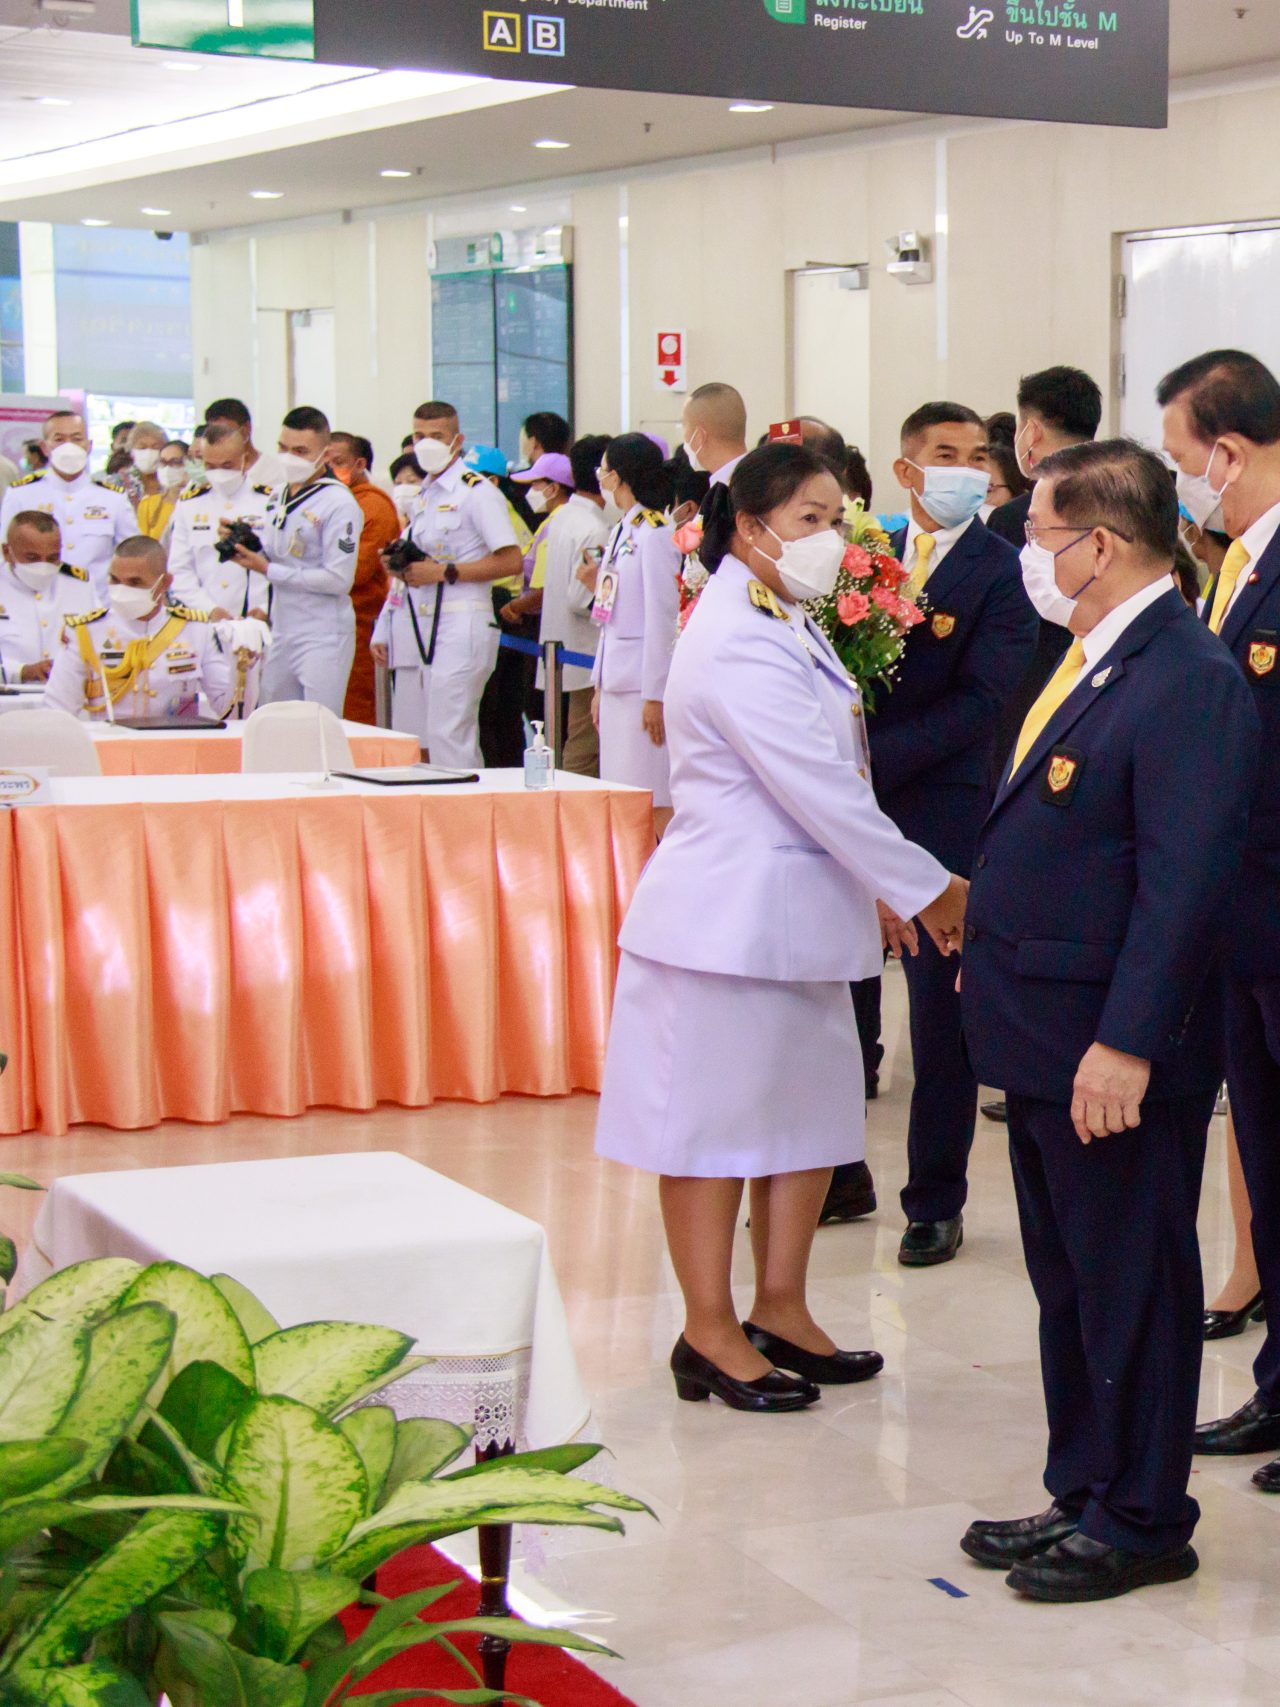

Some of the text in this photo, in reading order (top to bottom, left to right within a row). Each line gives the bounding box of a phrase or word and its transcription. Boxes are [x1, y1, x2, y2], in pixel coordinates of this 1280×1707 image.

[568, 0, 649, 10] epartment
[814, 13, 868, 30] Register
[1098, 11, 1117, 32] M
[490, 18, 557, 49] A B
[1005, 30, 1099, 49] Up To M Level
